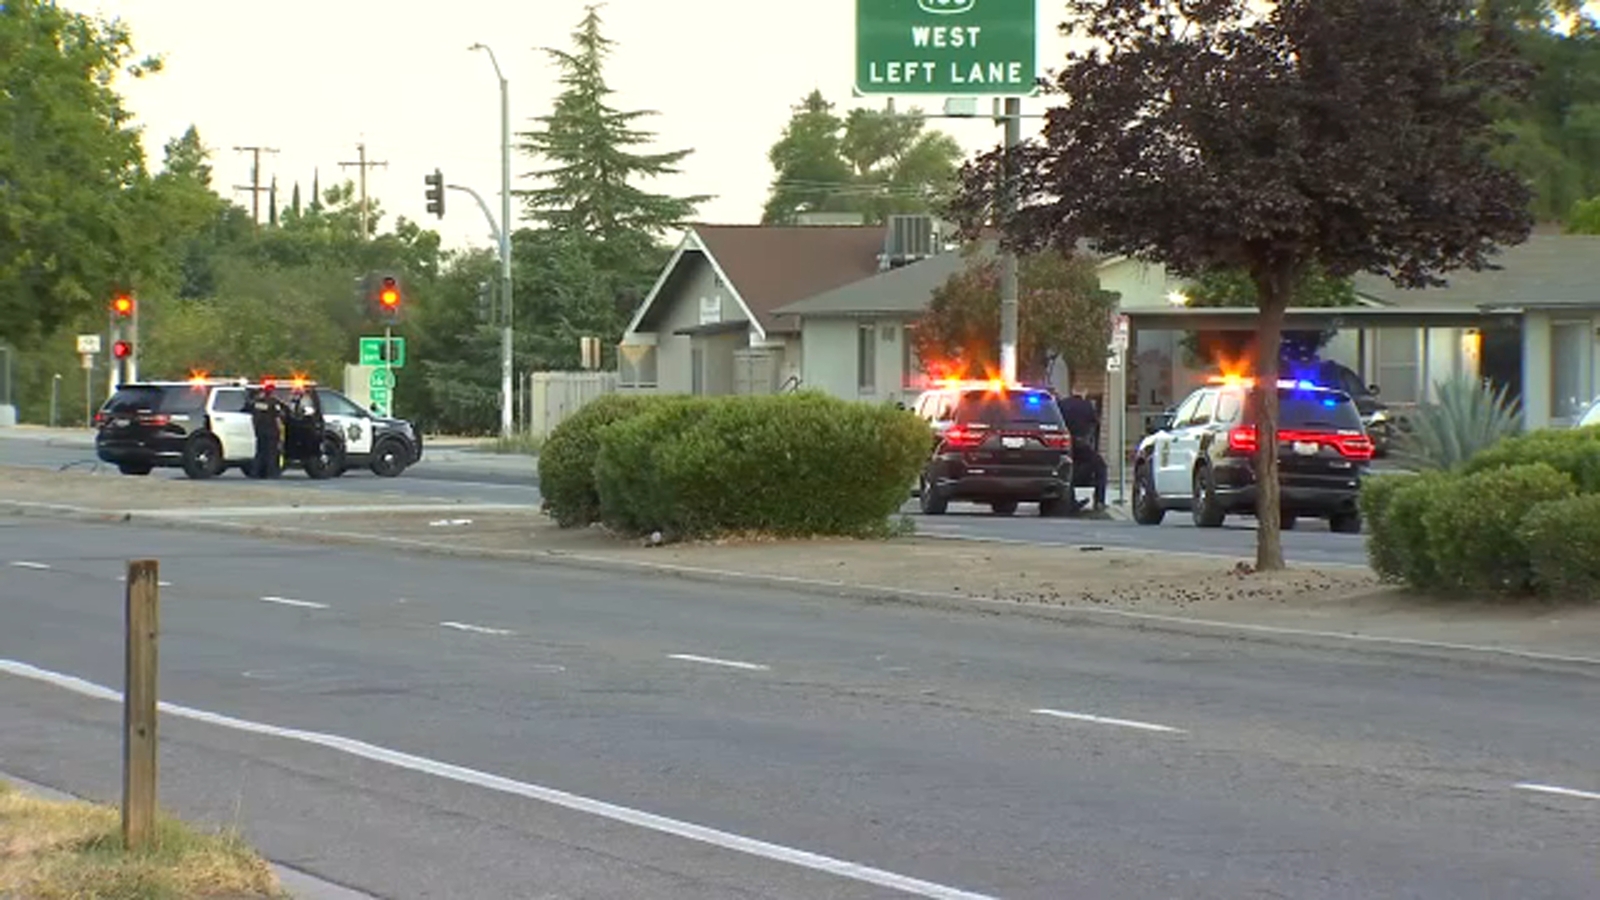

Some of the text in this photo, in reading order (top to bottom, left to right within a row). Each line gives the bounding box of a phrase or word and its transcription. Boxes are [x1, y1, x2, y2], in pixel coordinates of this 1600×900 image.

[912, 27, 980, 47] WEST
[869, 62, 1021, 83] LEFT LANE
